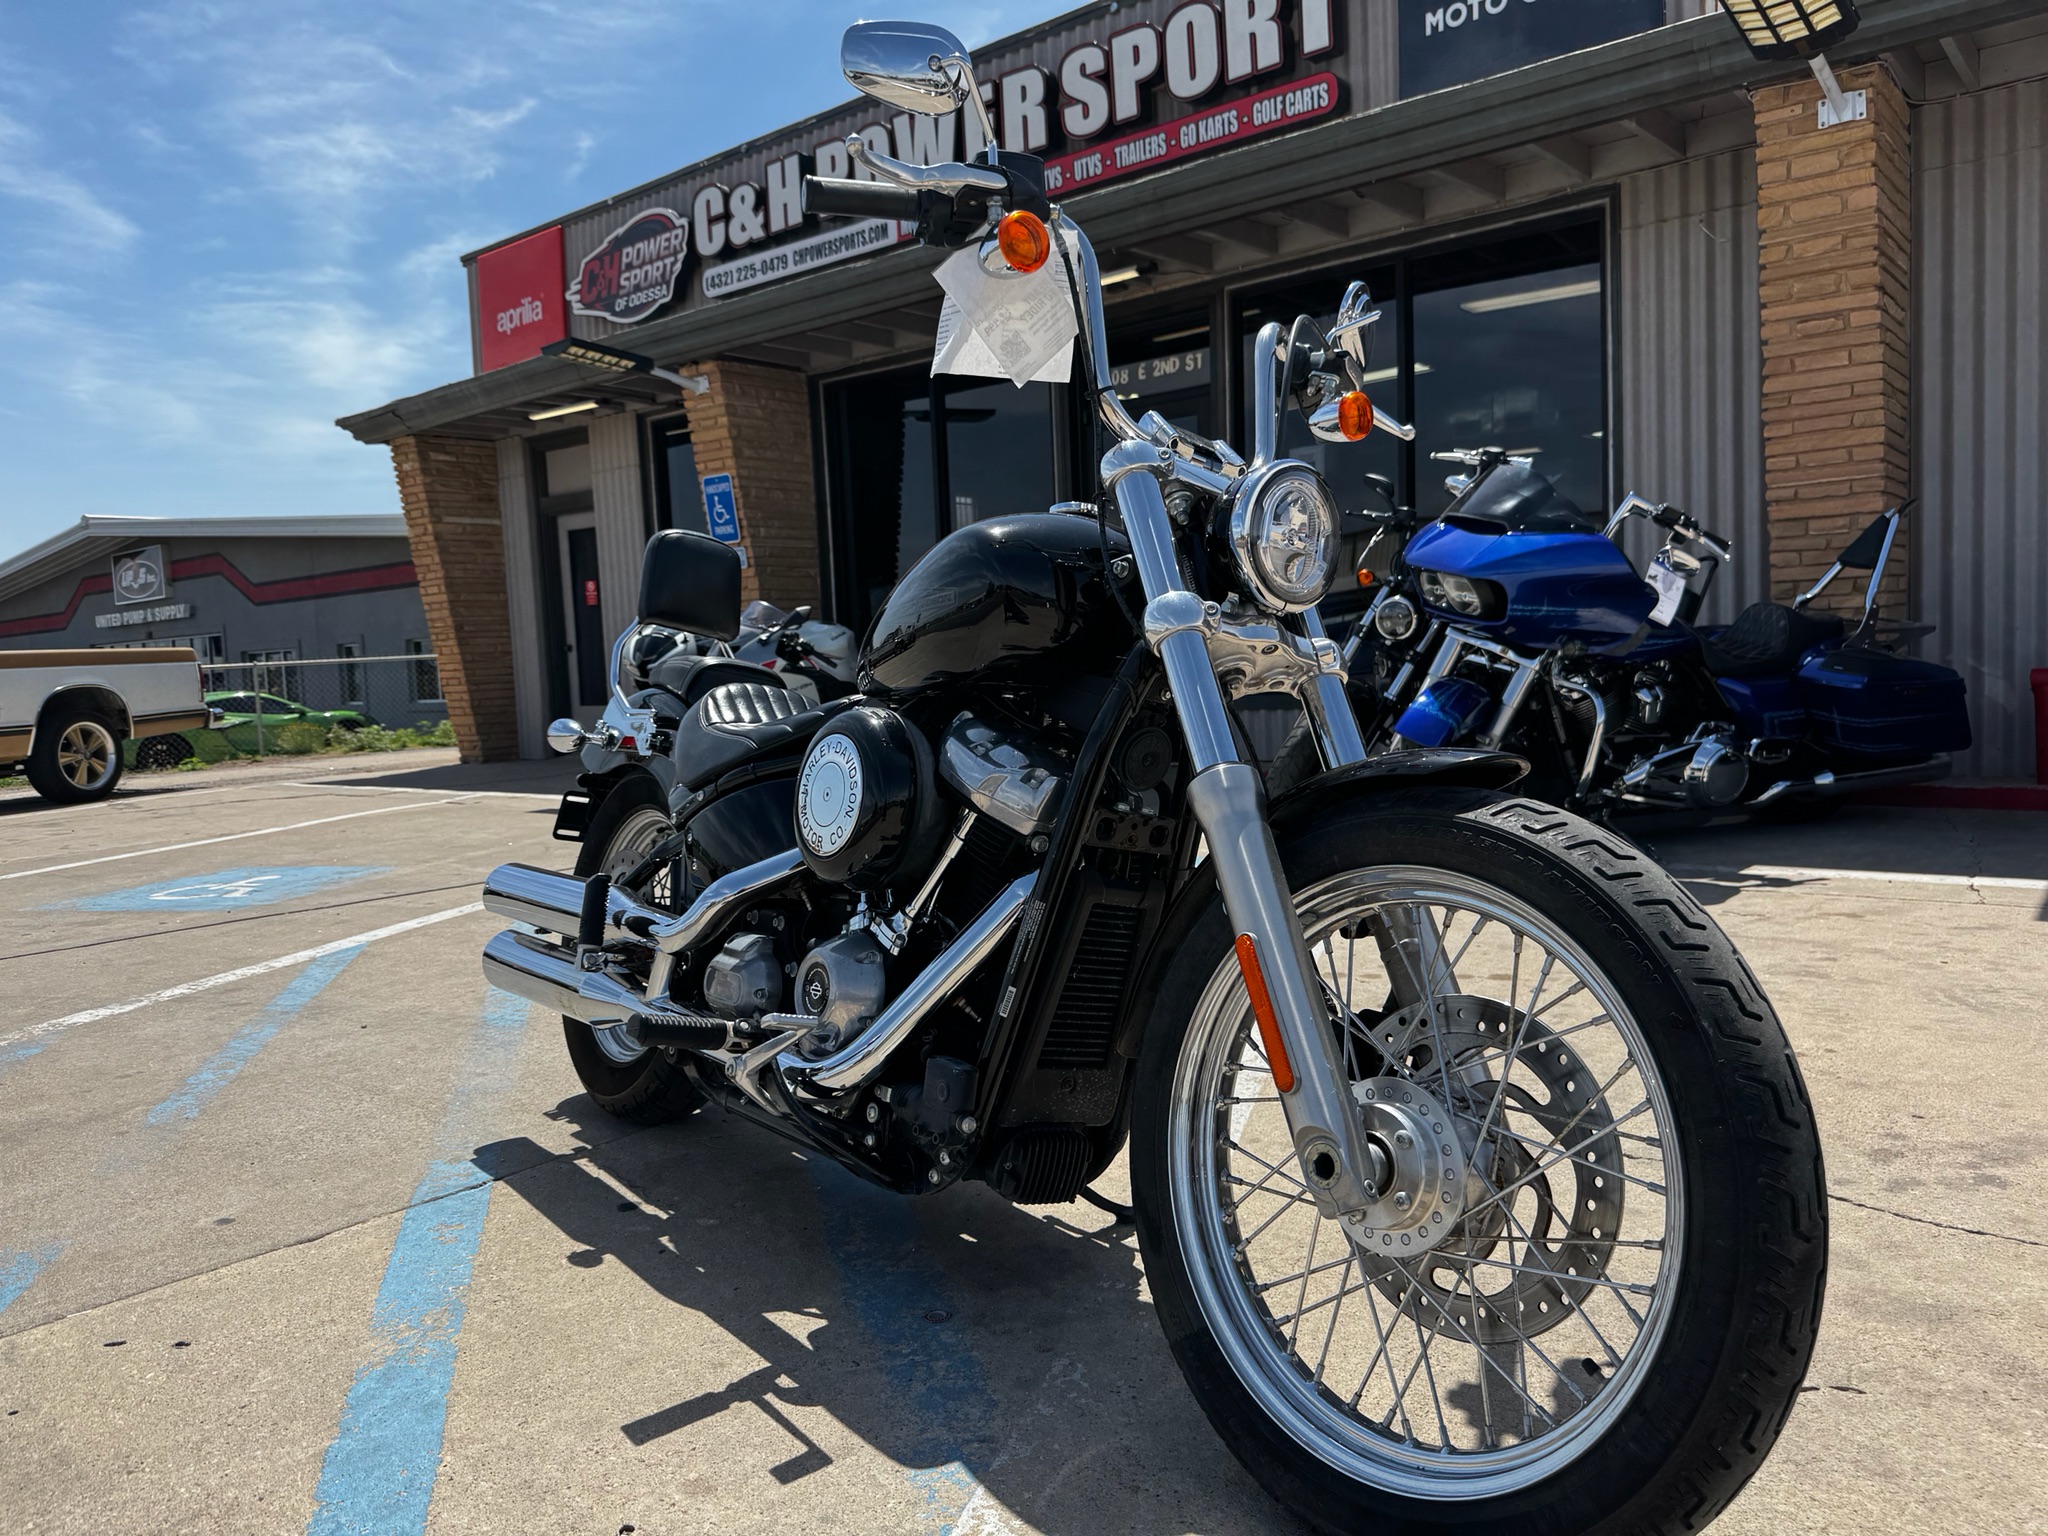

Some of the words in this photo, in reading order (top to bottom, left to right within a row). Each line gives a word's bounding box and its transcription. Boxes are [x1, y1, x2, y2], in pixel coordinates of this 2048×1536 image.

[1425, 0, 1508, 36] MOTO
[1073, 153, 1103, 182] UTVS
[1114, 132, 1167, 169] TRAILERS
[1179, 126, 1197, 149] GO
[1198, 109, 1239, 144] KARTS
[1252, 96, 1285, 127] GOLF
[1285, 82, 1330, 117] CARTS
[694, 151, 804, 257] C&H
[621, 227, 684, 271] POWER
[705, 272, 735, 292] (432)
[737, 253, 790, 284] 225-0479
[792, 222, 889, 267] CHPOWERSPORTS.COM
[580, 250, 620, 304] C&H
[615, 295, 628, 312] OF
[629, 284, 668, 308] ODESSA
[497, 296, 543, 335] aprilia
[1138, 362, 1147, 380] E
[1152, 357, 1180, 377] 2ND
[1185, 353, 1203, 372] ST
[95, 612, 121, 628] UNITED
[123, 609, 144, 626] PUMP
[146, 607, 153, 622] &
[155, 604, 185, 621] SUPPLY
[799, 808, 824, 850] MOTOR
[830, 825, 847, 846] CO.
